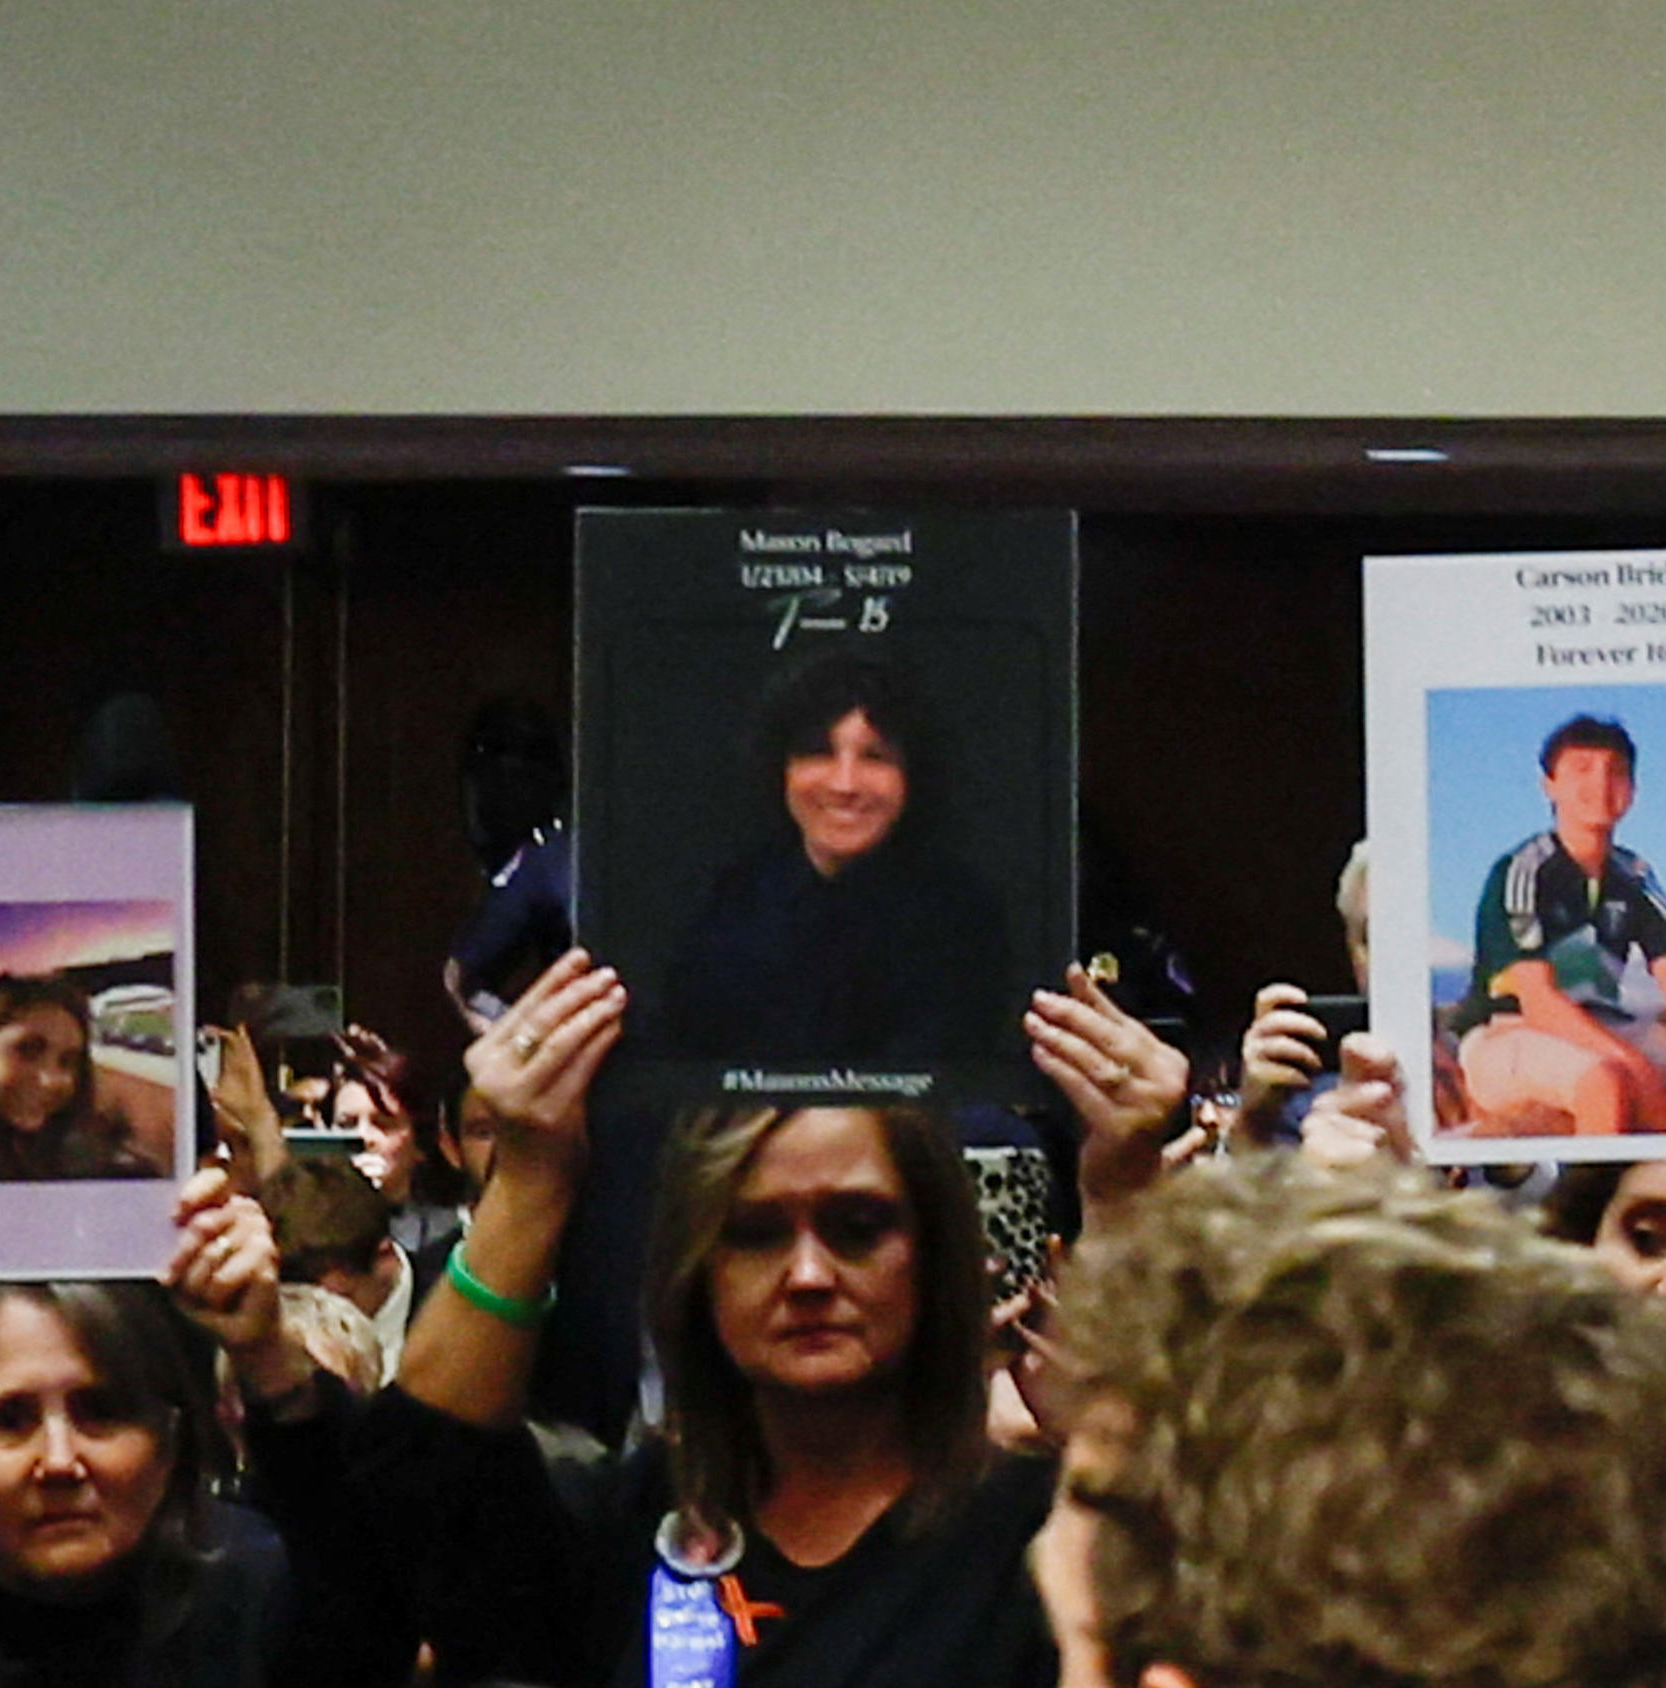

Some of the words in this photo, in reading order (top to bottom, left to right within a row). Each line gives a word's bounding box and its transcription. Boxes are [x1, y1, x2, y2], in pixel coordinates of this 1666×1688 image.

[179, 471, 289, 545] EXIT
[1516, 566, 1609, 588] Carson
[1531, 603, 1591, 627] 2003
[1537, 644, 1638, 666] Forever
